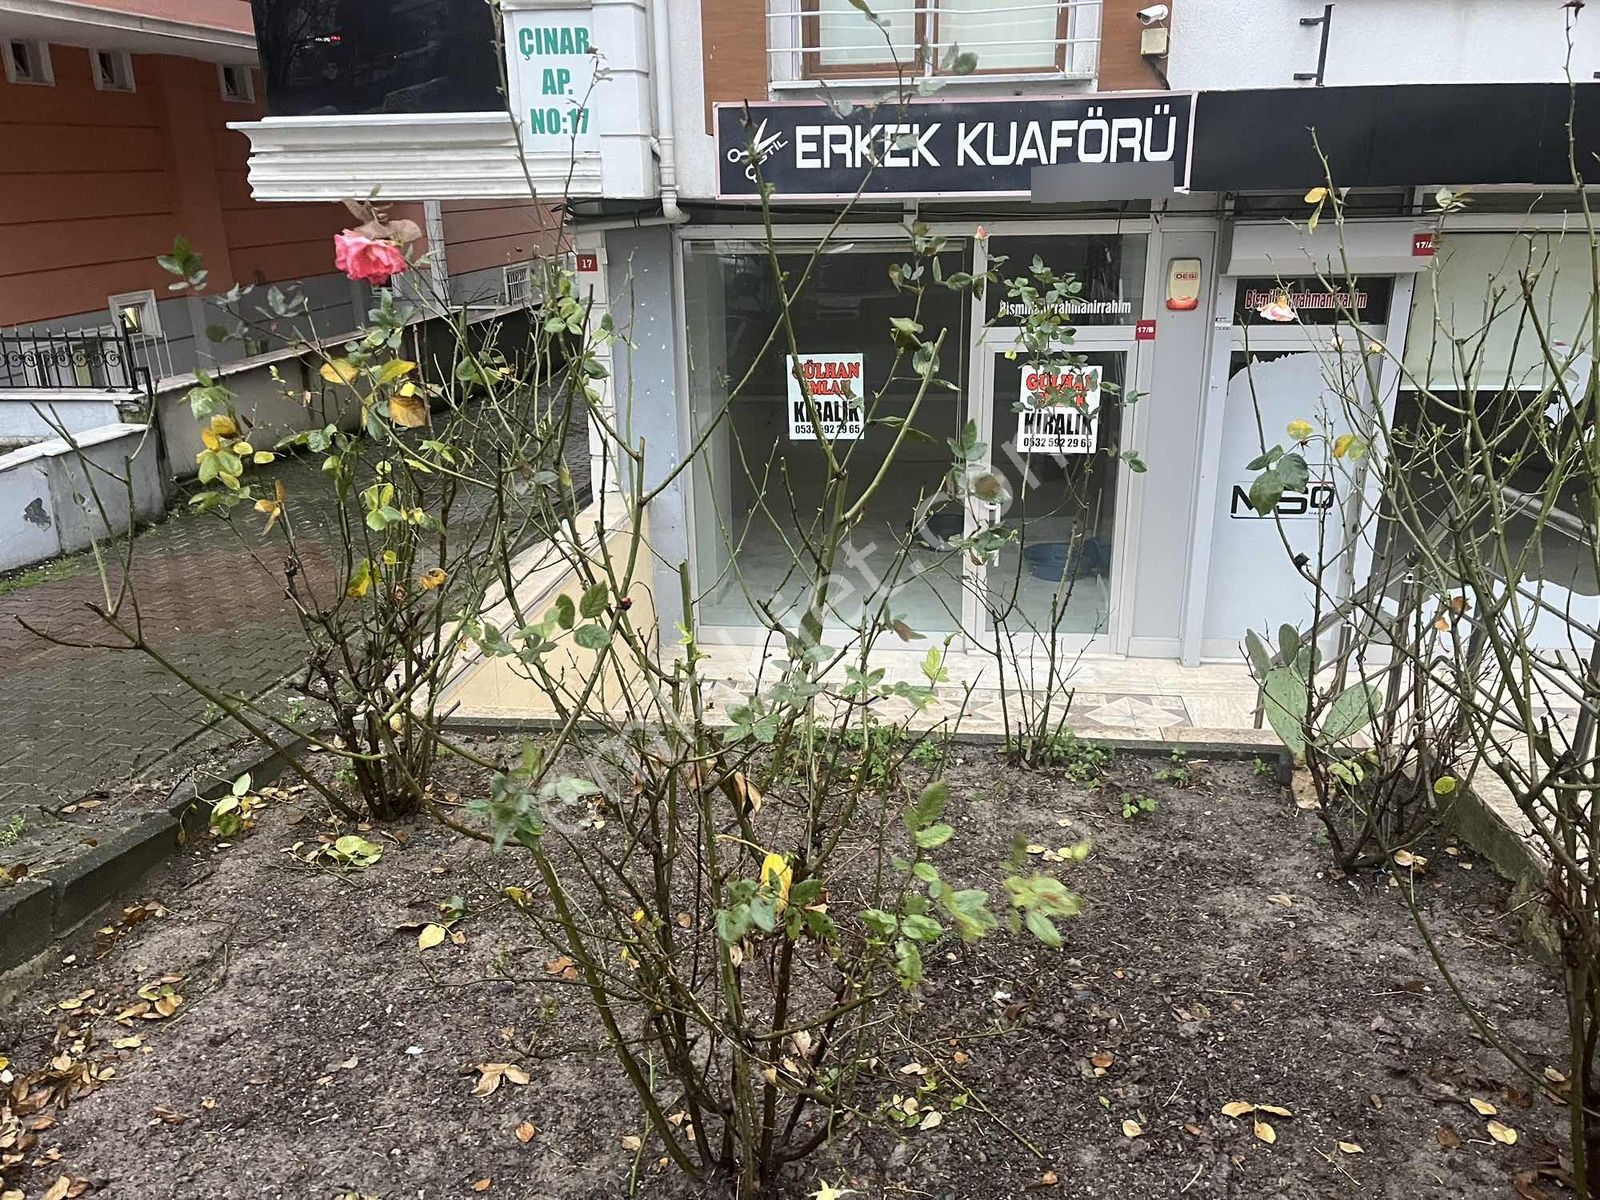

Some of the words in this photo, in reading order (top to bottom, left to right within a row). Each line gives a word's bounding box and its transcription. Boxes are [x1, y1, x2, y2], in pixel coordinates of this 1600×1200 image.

[518, 27, 589, 61] ÇINAR
[542, 68, 574, 95] AP.
[530, 108, 590, 135] NO:17
[795, 122, 942, 169] ERKEK
[957, 103, 1177, 166] KUAFÖRÜ
[582, 259, 593, 269] 17
[1136, 326, 1155, 334] 17/B
[806, 379, 852, 395] MLA
[819, 424, 835, 434] 92
[849, 424, 860, 434] 65
[1023, 437, 1046, 447] 0532
[1048, 437, 1066, 447] 592
[1067, 437, 1079, 447] 29
